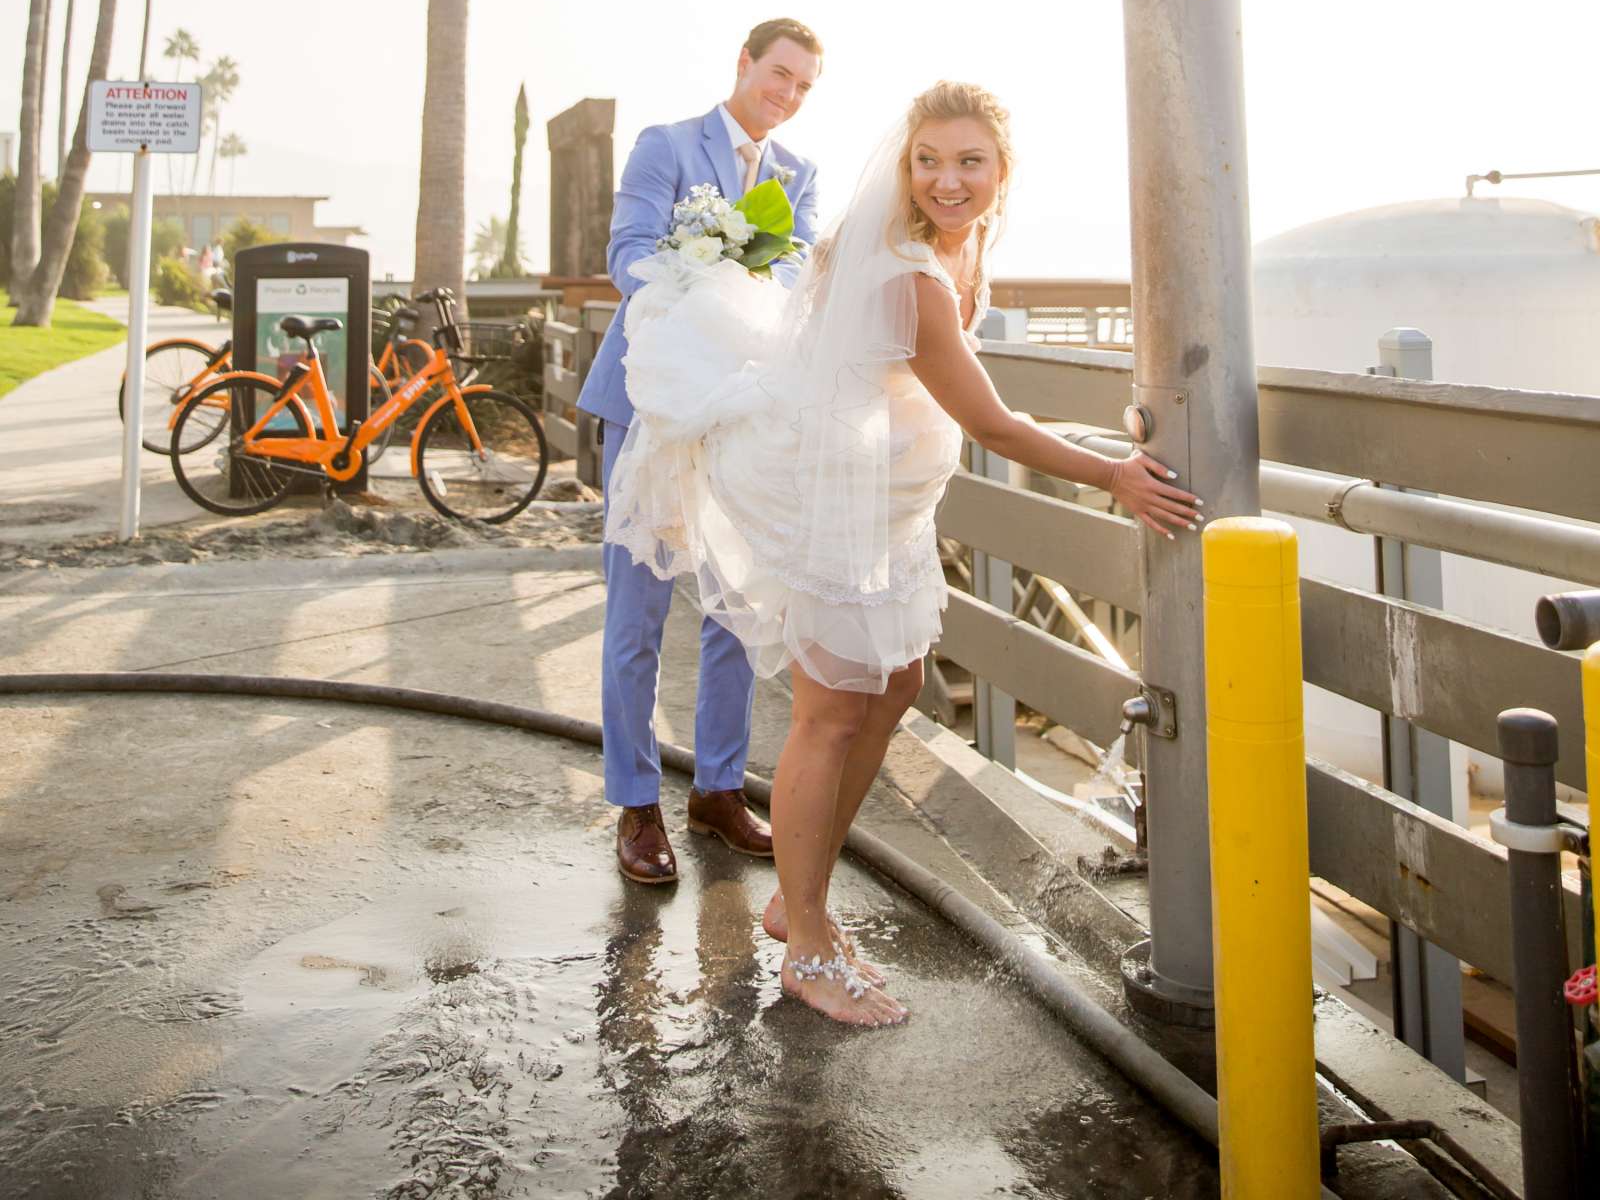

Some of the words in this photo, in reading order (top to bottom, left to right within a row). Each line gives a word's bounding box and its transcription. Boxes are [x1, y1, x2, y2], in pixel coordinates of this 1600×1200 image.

[106, 88, 187, 101] ATTENTION
[136, 103, 151, 111] pull
[166, 120, 190, 128] catch
[402, 377, 426, 401] SPIN
